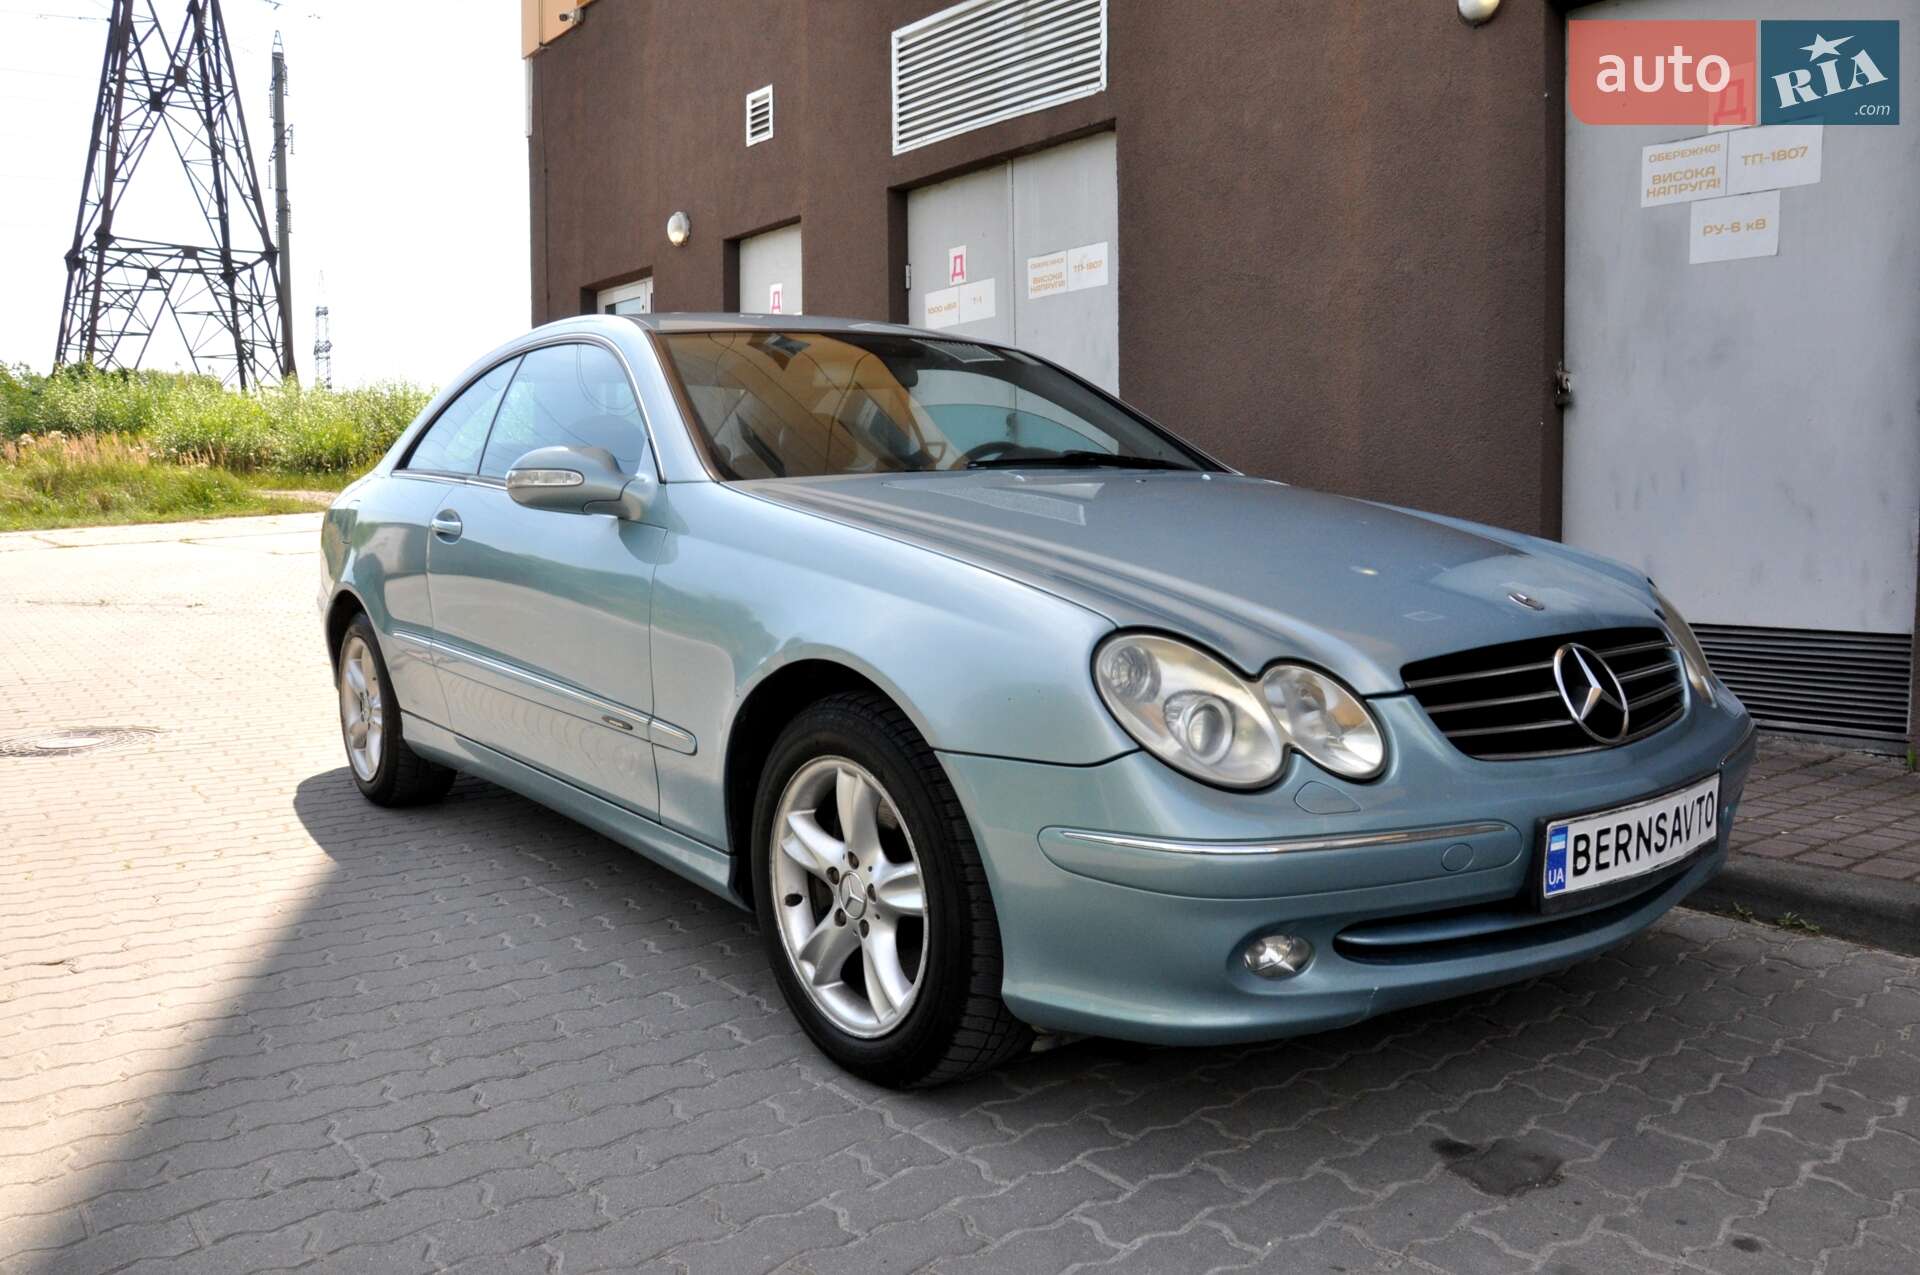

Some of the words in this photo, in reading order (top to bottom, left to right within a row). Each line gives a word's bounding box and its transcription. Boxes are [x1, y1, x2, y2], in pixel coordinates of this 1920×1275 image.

[1648, 144, 1721, 163] ОБЕРЕЖНО!
[1742, 146, 1808, 166] ТП-1807
[1652, 166, 1716, 184] ВИСОКА
[1646, 178, 1721, 198] НАПРУГА!
[951, 254, 965, 282] Д
[1572, 790, 1715, 877] BERNSAVTO
[1548, 868, 1565, 885] UA
